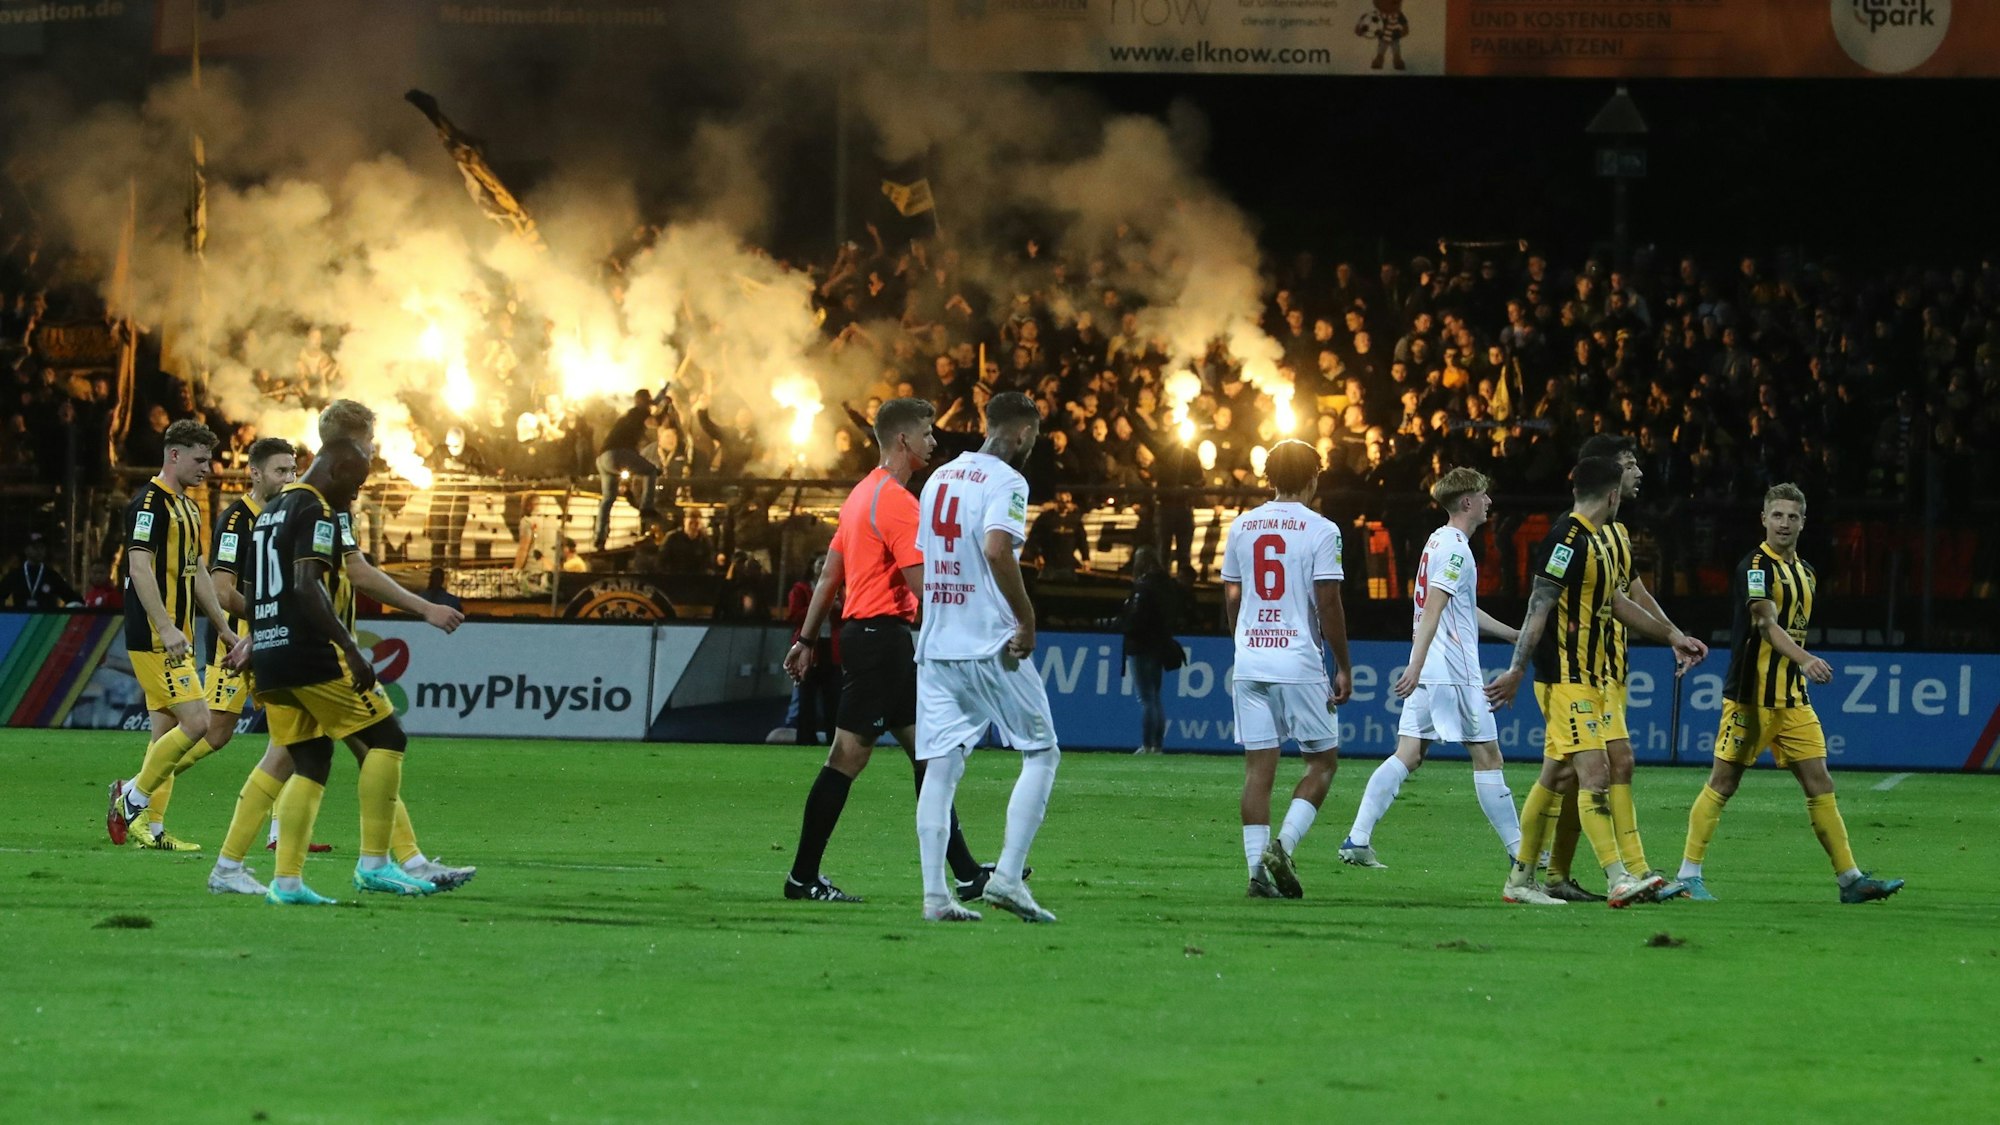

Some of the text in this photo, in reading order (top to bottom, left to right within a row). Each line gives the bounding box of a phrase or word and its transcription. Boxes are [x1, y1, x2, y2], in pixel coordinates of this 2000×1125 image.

[1470, 12, 1672, 29] UND KOSTENLOSEN
[1869, 6, 1935, 33] park
[1110, 41, 1331, 63] www.elknow.com
[931, 483, 962, 553] 4
[1241, 519, 1279, 531] FORTUNA
[252, 526, 284, 600] 16
[1253, 534, 1287, 601] 6
[1258, 609, 1282, 623] EZE
[1247, 637, 1290, 648] AUDIO
[415, 673, 632, 721] myPhysio
[1842, 664, 1972, 716] Ziel
